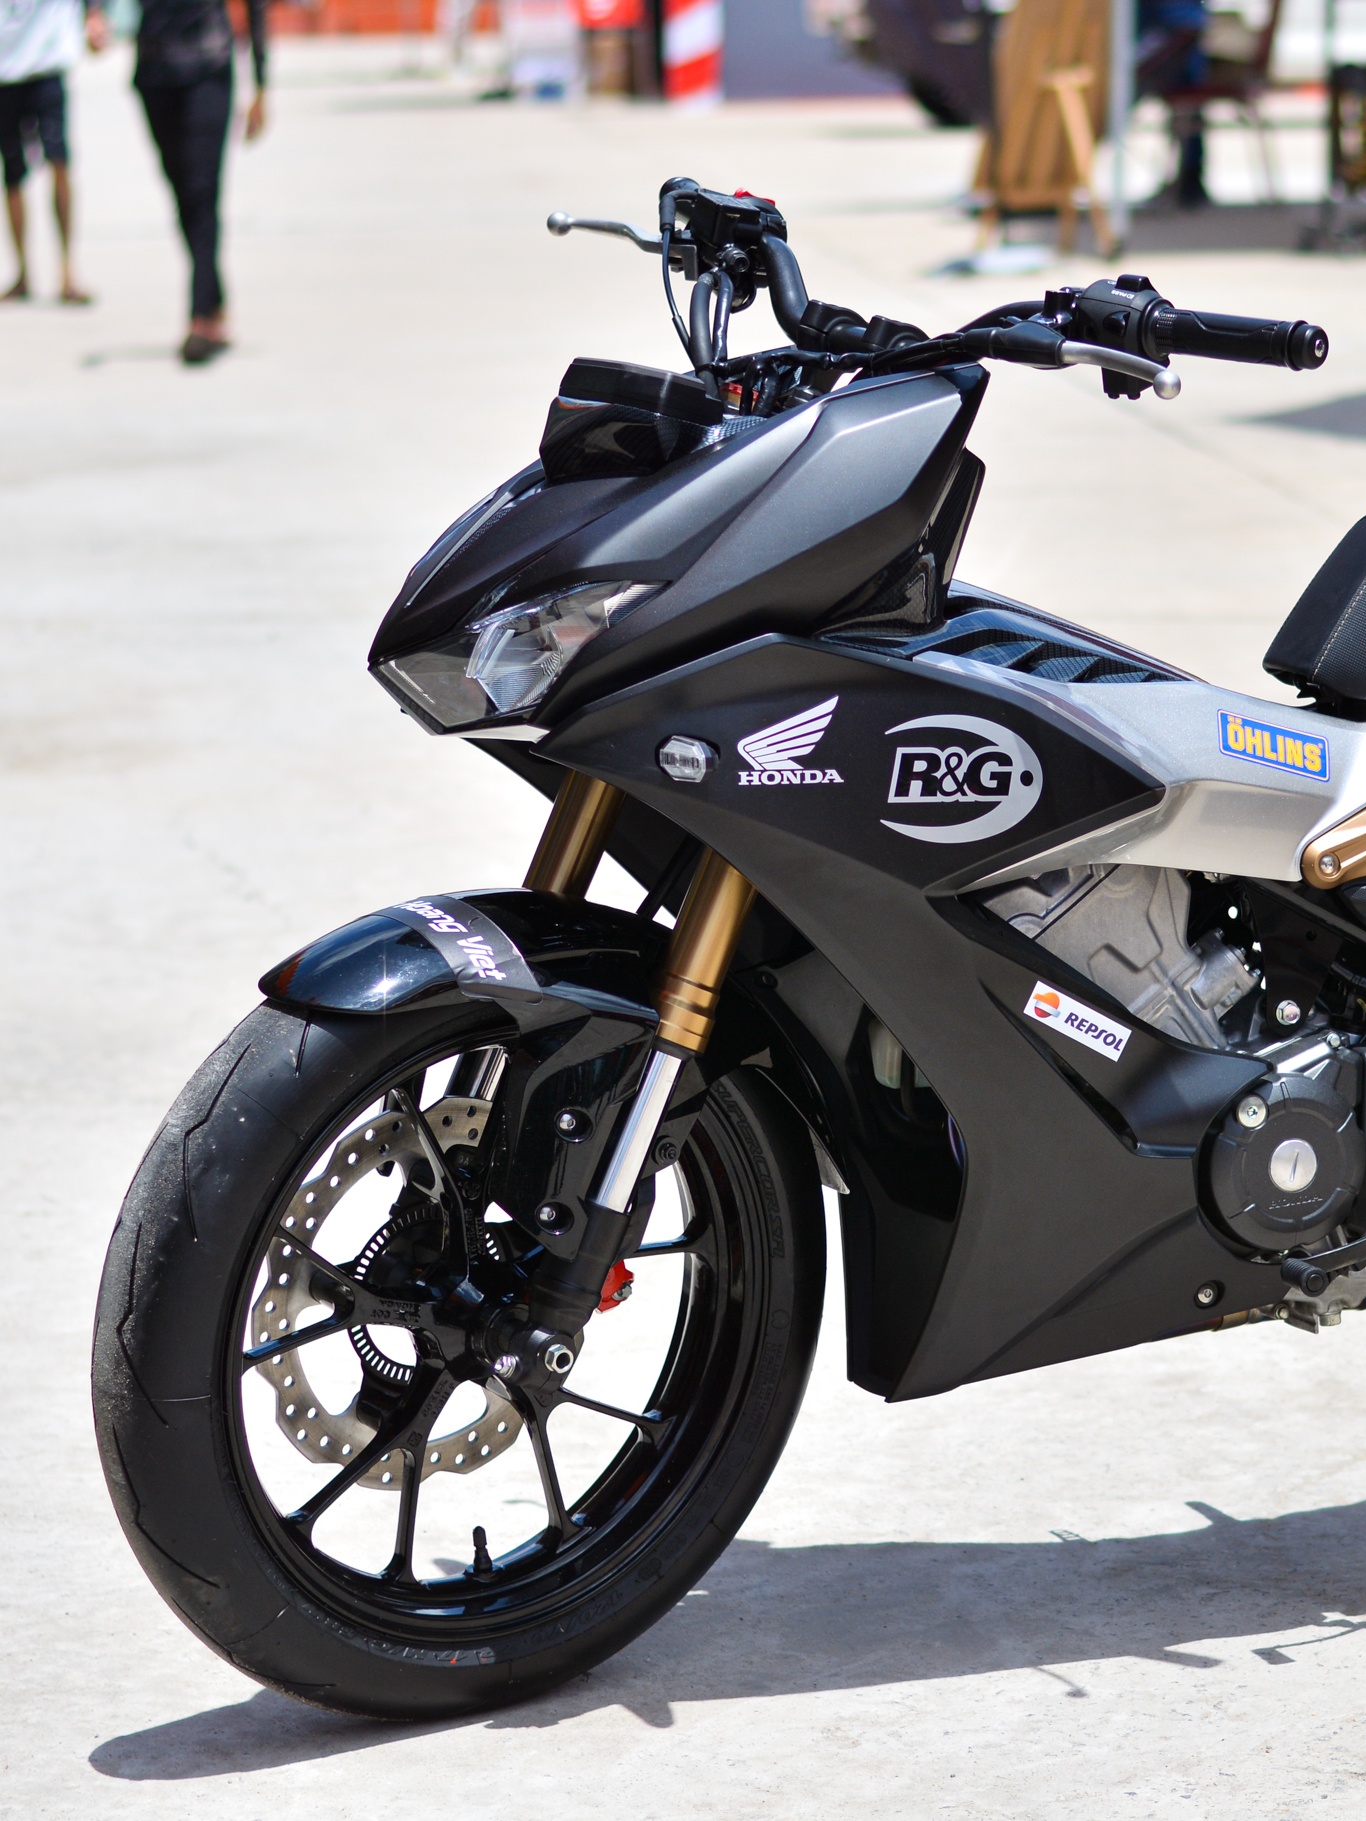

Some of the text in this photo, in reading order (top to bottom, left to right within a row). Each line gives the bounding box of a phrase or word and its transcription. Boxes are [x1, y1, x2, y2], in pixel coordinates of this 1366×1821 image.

[1226, 714, 1322, 773] ÖHLINS
[738, 769, 844, 786] HONDA
[889, 747, 1016, 801] R&G
[456, 935, 507, 981] Viet
[1064, 1012, 1124, 1052] REPSOL
